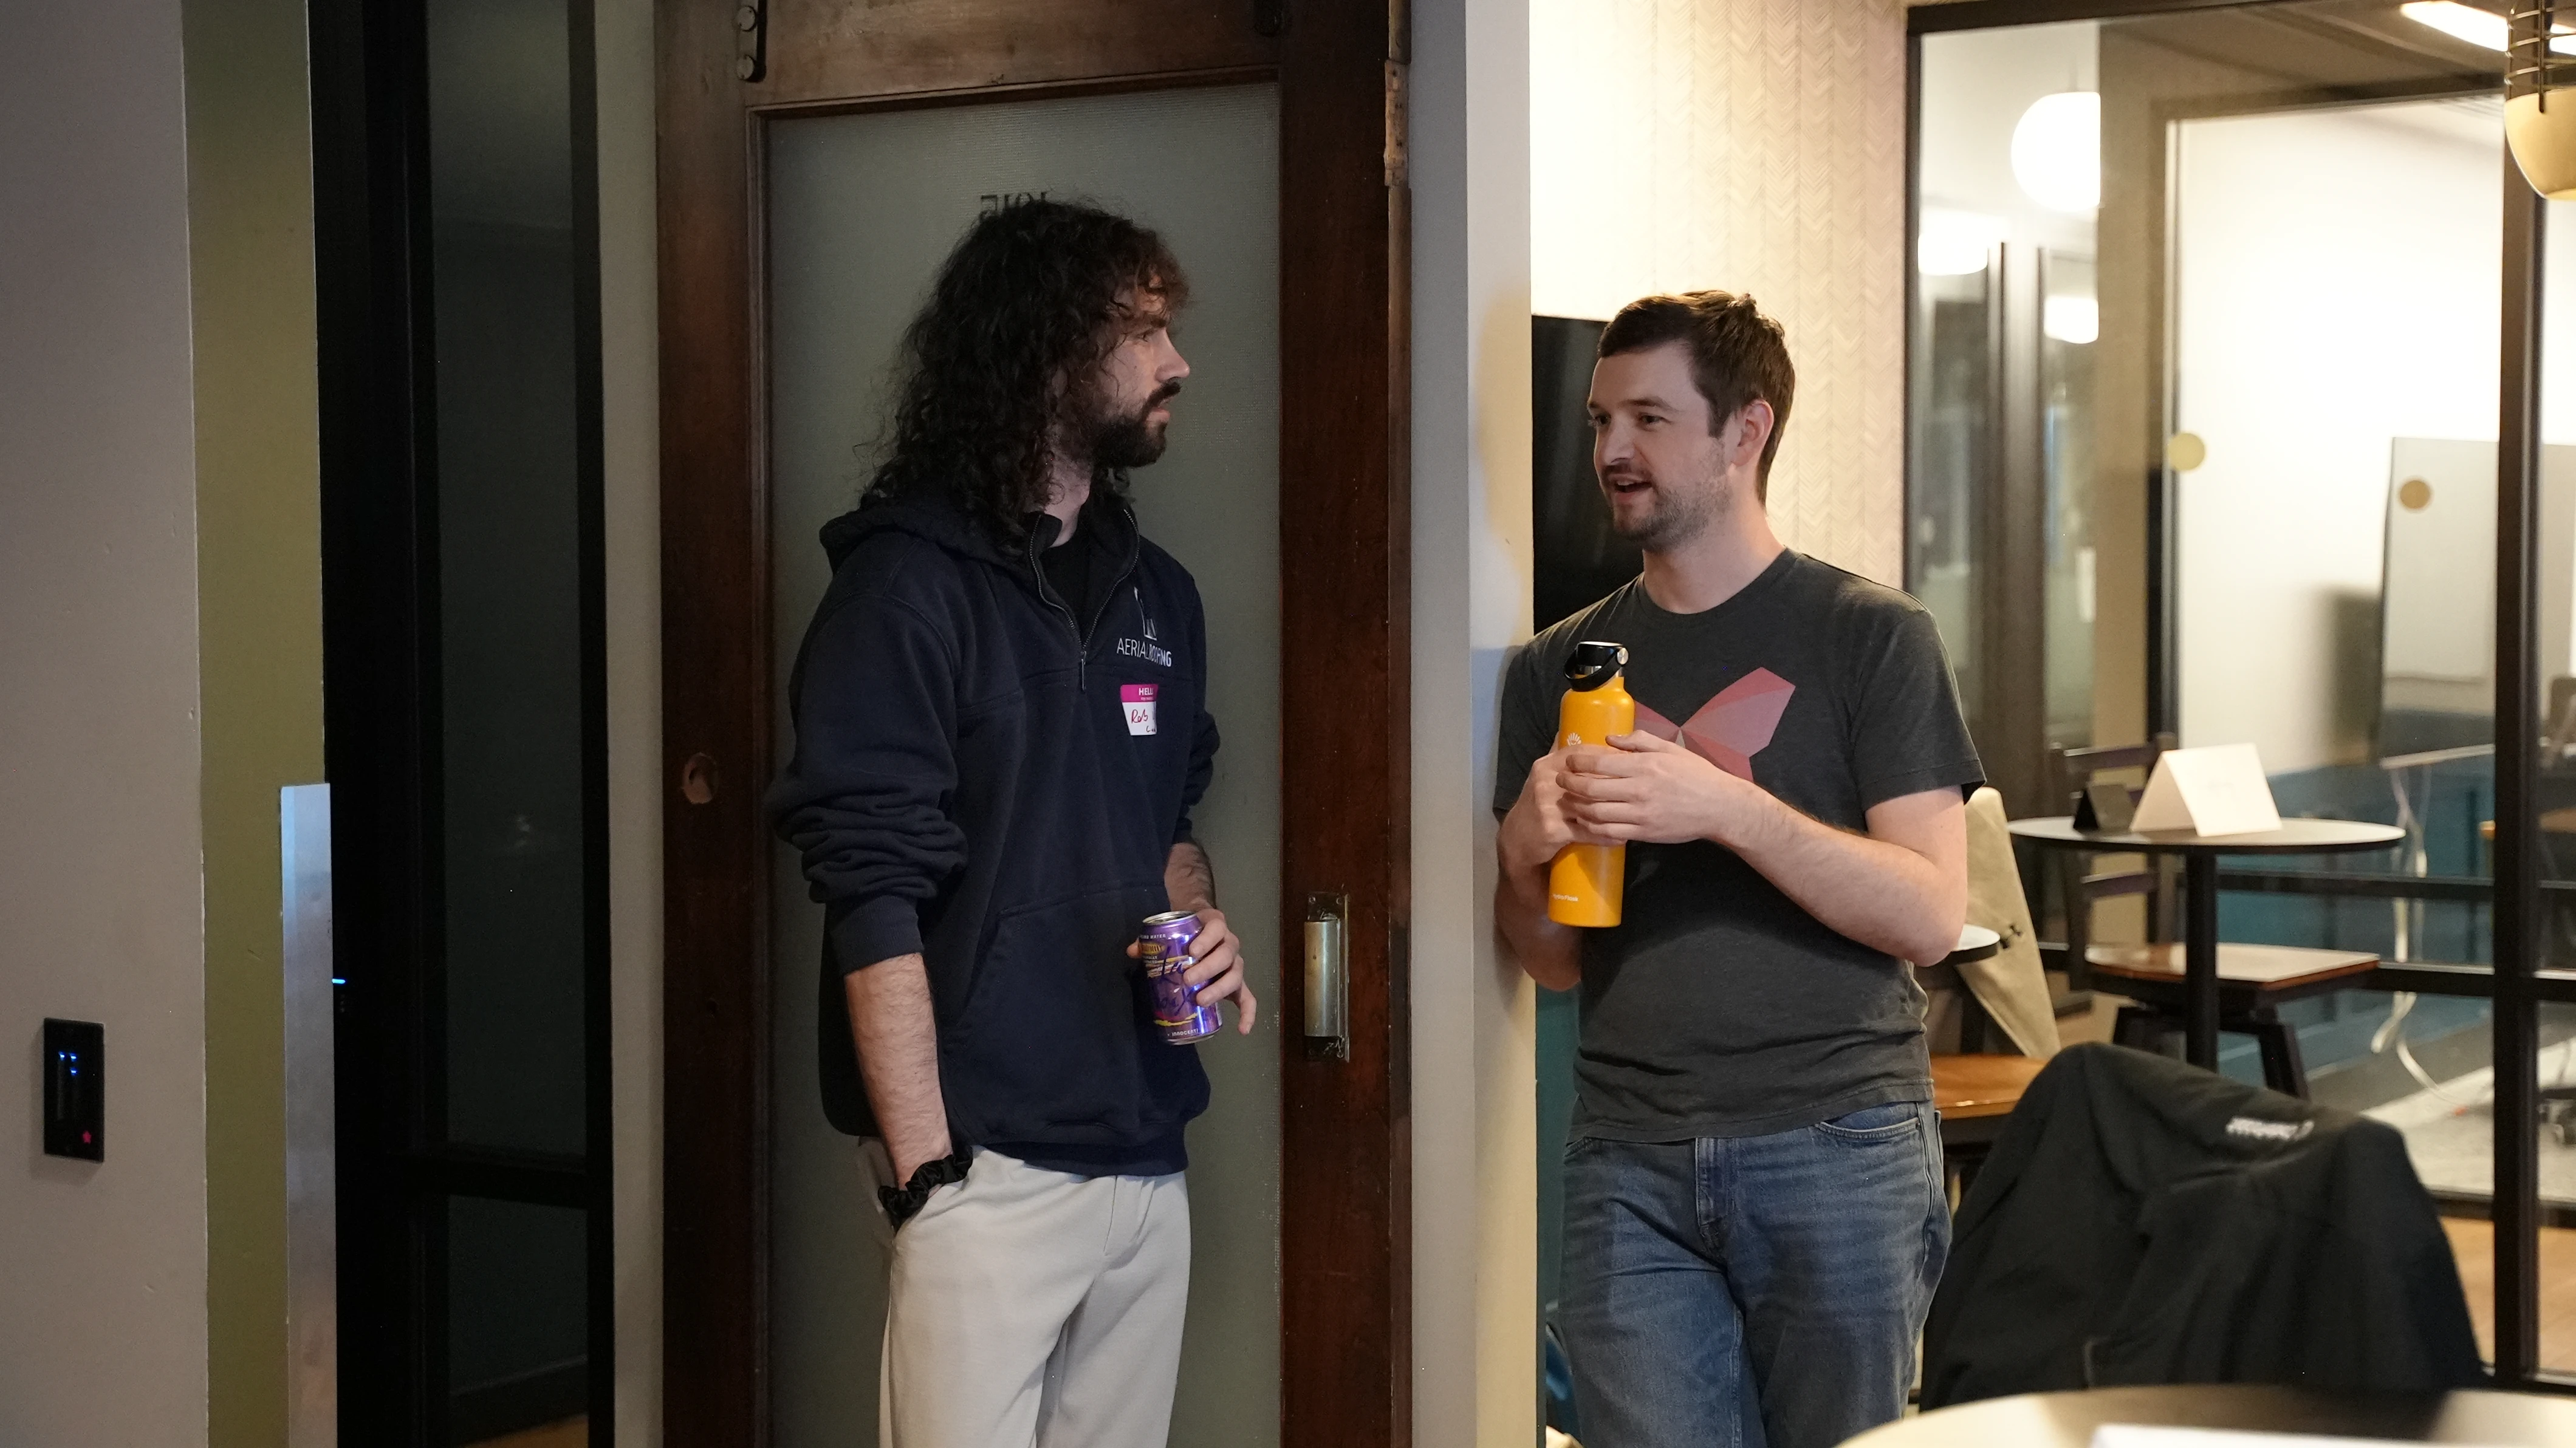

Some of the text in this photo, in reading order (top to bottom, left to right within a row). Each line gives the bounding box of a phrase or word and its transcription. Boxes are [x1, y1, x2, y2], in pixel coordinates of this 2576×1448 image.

[1117, 638, 1150, 660] AERIAL
[1139, 688, 1153, 696] HELL
[1131, 709, 1148, 723] Rob
